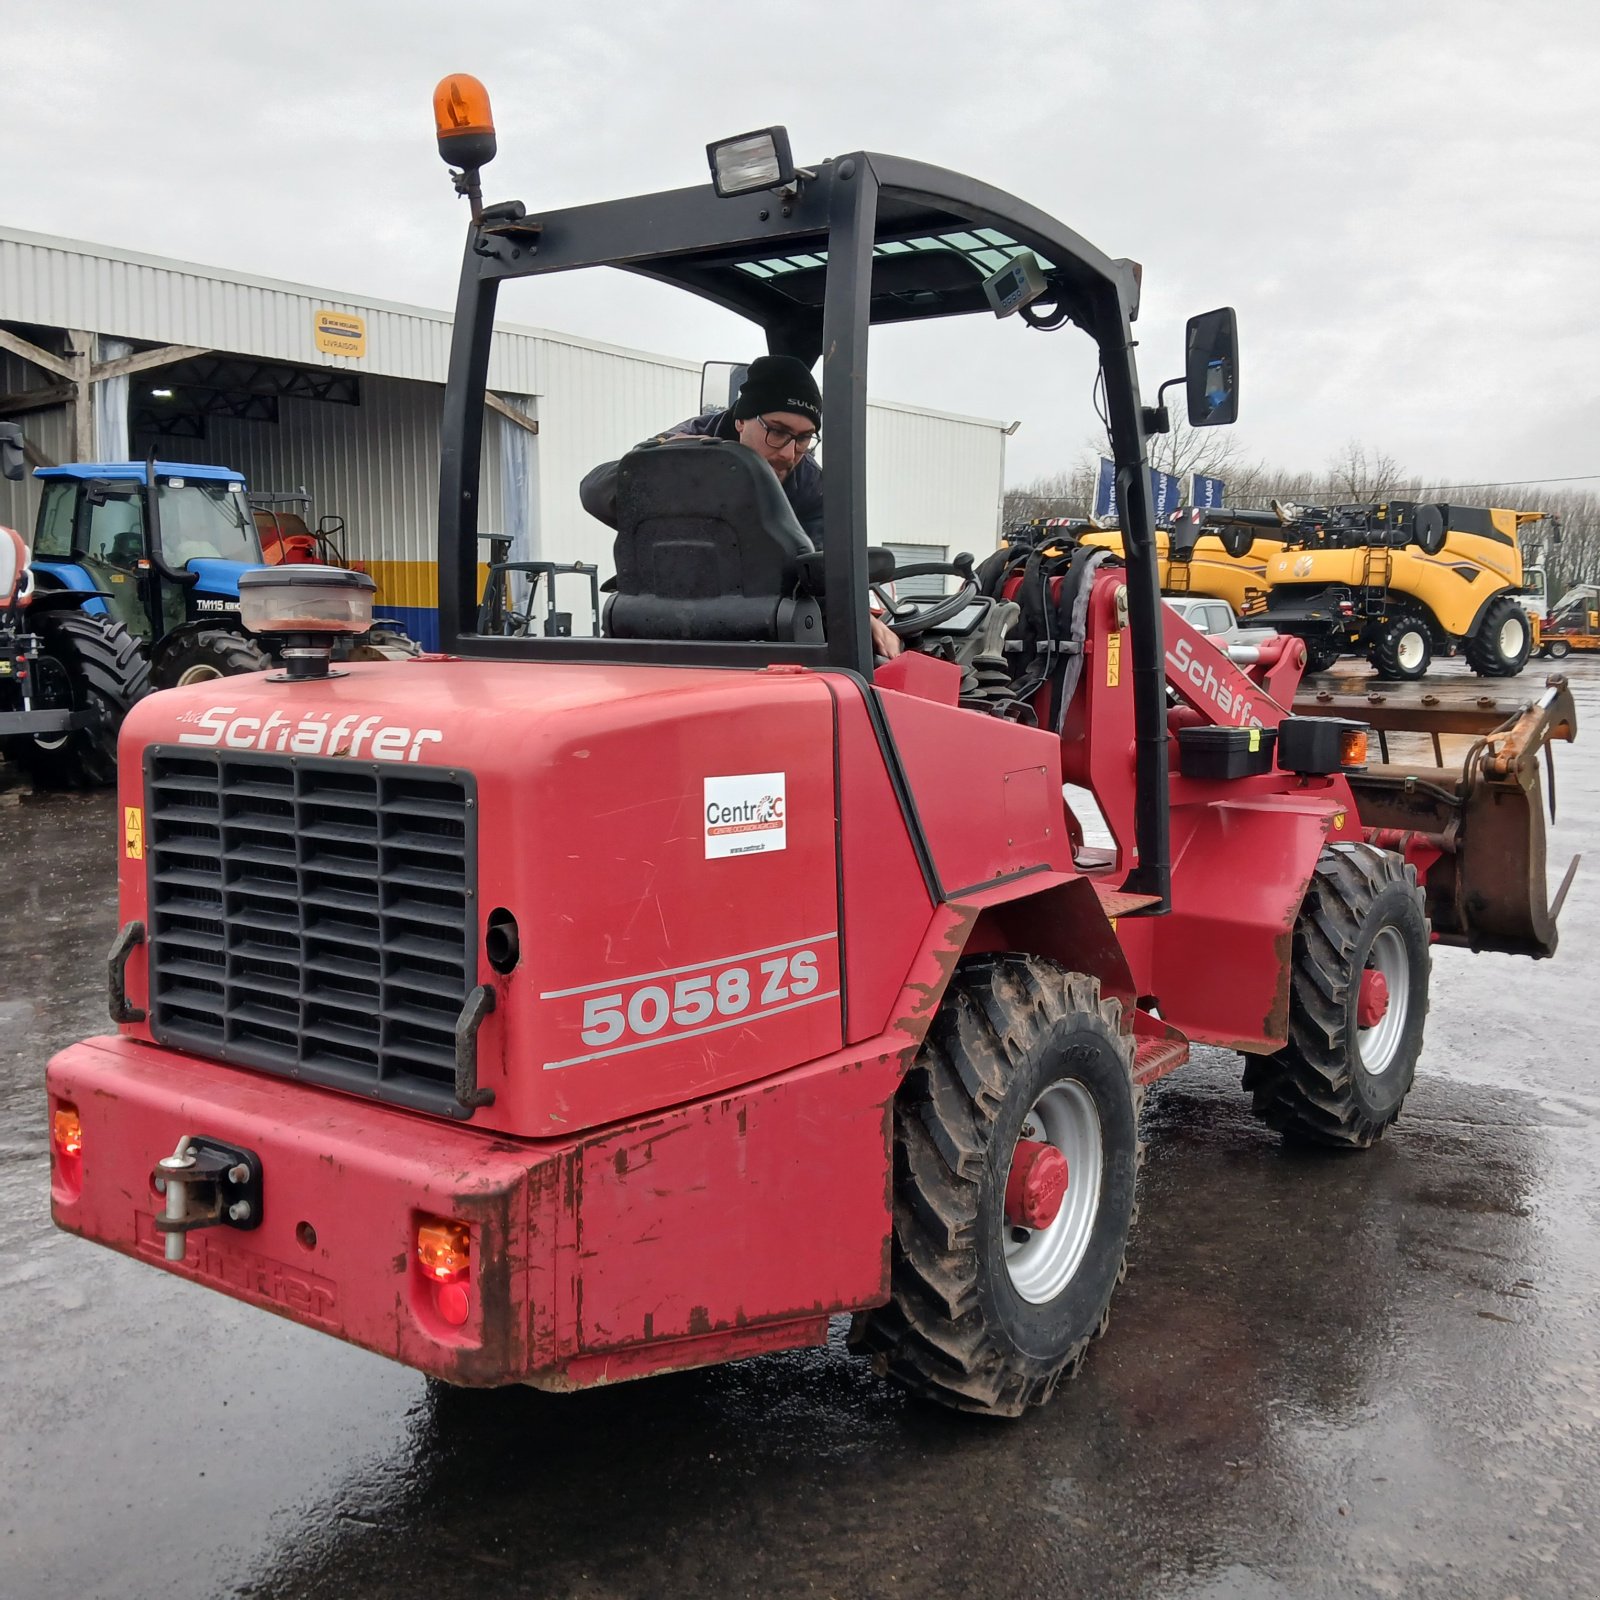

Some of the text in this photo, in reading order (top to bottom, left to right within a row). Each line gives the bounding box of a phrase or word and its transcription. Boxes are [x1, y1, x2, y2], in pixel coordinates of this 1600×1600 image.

[323, 339, 358, 351] LIVRAISON
[196, 600, 224, 610] TM115
[178, 706, 443, 762] Schäffer
[580, 950, 820, 1047] 5058 ZS
